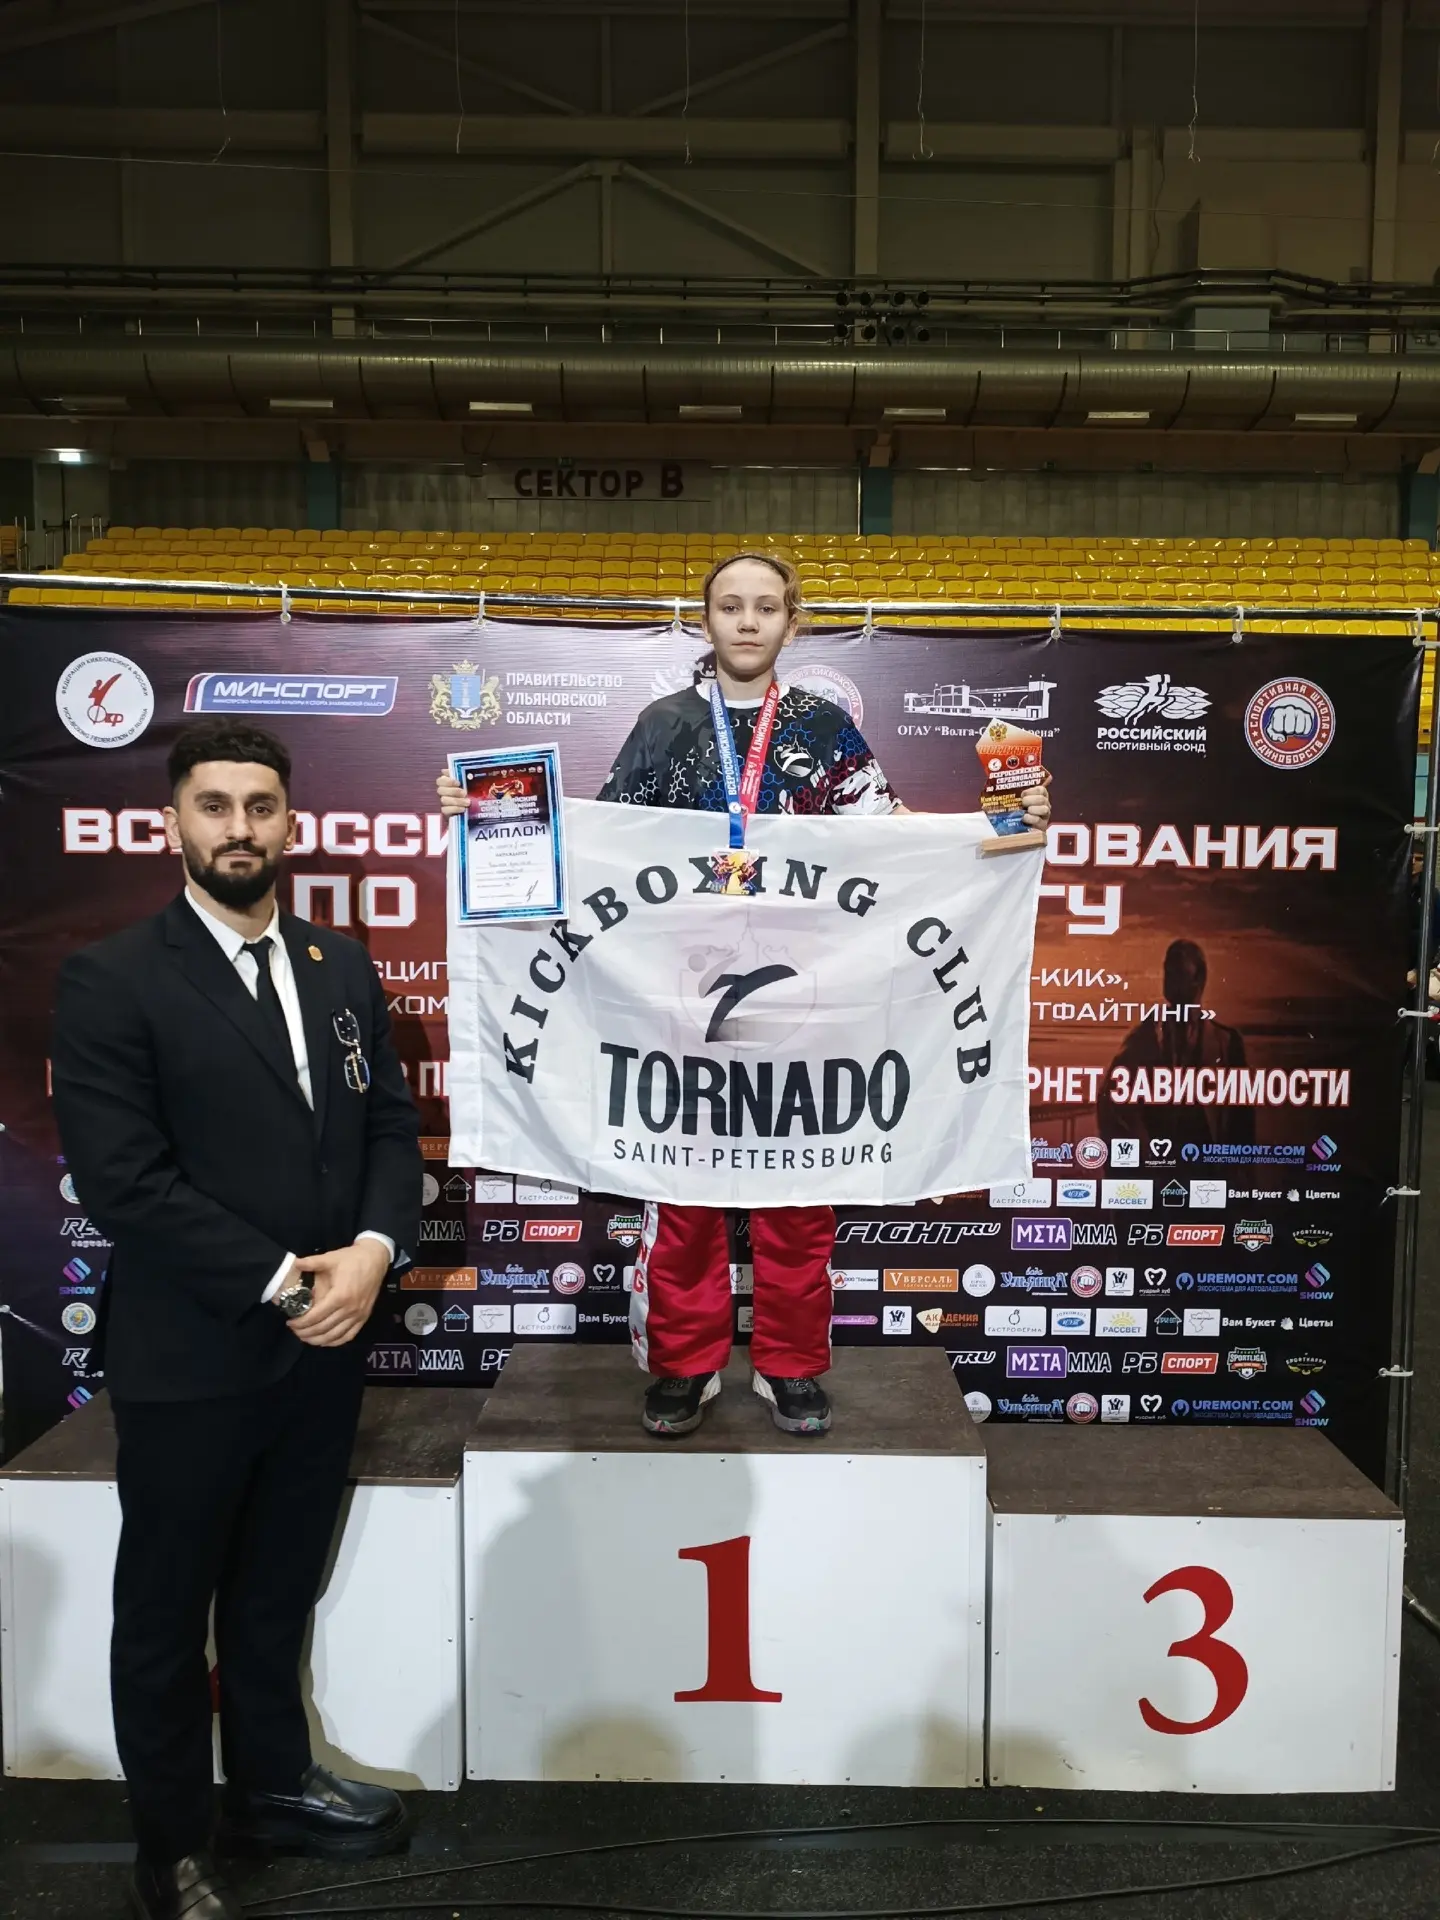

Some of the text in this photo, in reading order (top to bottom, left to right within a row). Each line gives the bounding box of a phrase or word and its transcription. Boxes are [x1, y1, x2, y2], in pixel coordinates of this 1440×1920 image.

[515, 465, 684, 498] СЕКТОР В
[132, 670, 148, 696] РОССИИ
[506, 672, 623, 688] ПРАВИТЕЛЬСТВО
[213, 681, 386, 699] МИНСПОРТ
[506, 691, 607, 707] УЛЬЯНОВСКОЙ
[506, 711, 571, 725] ОБЛАСТИ
[1249, 682, 1330, 764] СПОРТИВНАЯ ШКОЛА ЕДИНОБОРСТВ
[752, 699, 776, 753] КИКБОКСИНГУ
[897, 725, 931, 736] ОГАУ
[90, 733, 128, 743] FEDERATION
[1098, 725, 1207, 741] РОССИЙСКИЙ
[1096, 741, 1206, 753] СПОРТИВНЫЙ ФОНД
[475, 825, 546, 841] ДИПЛОМ
[1045, 823, 1339, 870] ОВАНИЯ
[292, 872, 416, 928] ПО
[503, 855, 992, 1085] KICKBOXING CLUB
[1031, 967, 1129, 991] -КИК»,
[1030, 997, 1216, 1023] ТФАЙТИНГ»
[600, 1042, 911, 1137] TORNADO
[1029, 1065, 1350, 1107] РНЕТ ЗАВИСИМОСТИ
[613, 1138, 893, 1170] SAINT-PETERSBURG
[1202, 1144, 1305, 1156] UREMONT.COM
[1306, 1163, 1341, 1172] SHOW
[1228, 1189, 1282, 1200] Вам Букет
[1305, 1189, 1340, 1200] Цветы
[1108, 1197, 1147, 1205] РАССВЕТ
[529, 1224, 576, 1237] СПОРТ
[609, 1221, 642, 1230] SPORTLIG
[1236, 1226, 1271, 1234] SPORTLIGA
[1173, 1229, 1218, 1241] СПОРТ
[1197, 1273, 1298, 1284] UREMONT.COM
[59, 1286, 96, 1295] SHOW
[1300, 1292, 1333, 1300] SHOW
[578, 1314, 599, 1323] Вам
[925, 1313, 979, 1322] АКАДЕМИЯ
[1222, 1317, 1276, 1328] Вам Букет
[1299, 1318, 1333, 1328] Цветы
[1167, 1357, 1212, 1369] СПОРТ
[1229, 1354, 1264, 1362] SPORTLIGA
[1192, 1400, 1293, 1411] UREMONT.COM
[1295, 1418, 1329, 1426] SHOW
[674, 1535, 783, 1704] 1
[1138, 1565, 1250, 1735] 3
